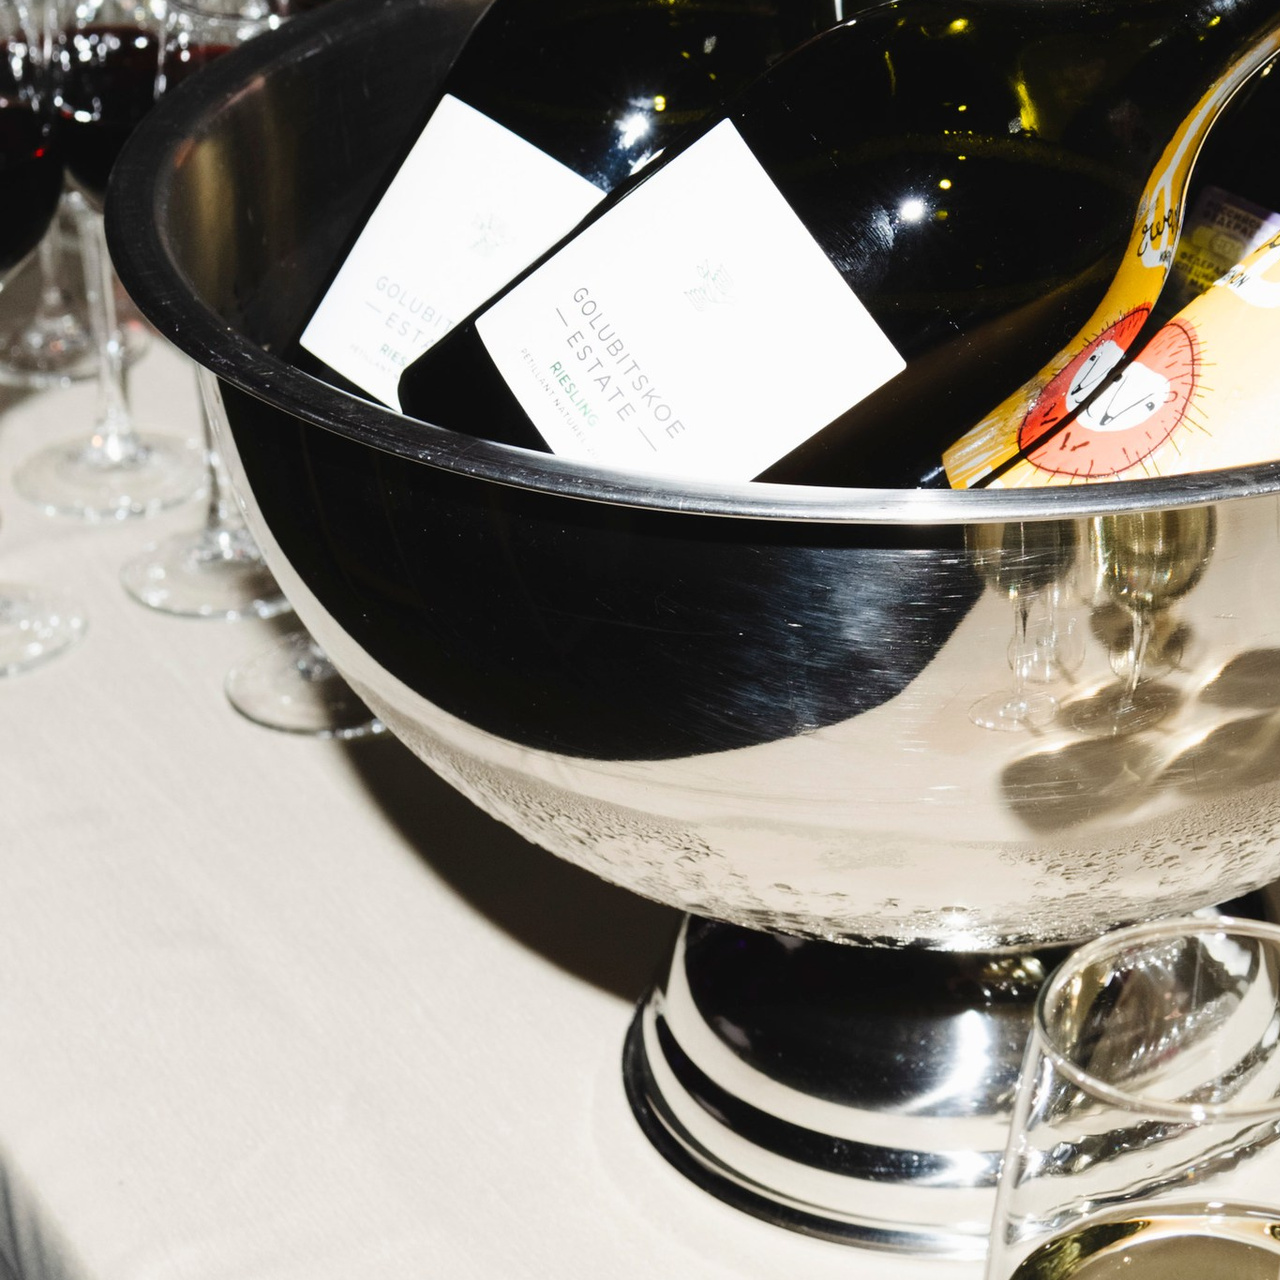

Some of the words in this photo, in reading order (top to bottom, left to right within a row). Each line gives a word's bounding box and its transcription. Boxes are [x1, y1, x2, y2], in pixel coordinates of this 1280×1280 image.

[375, 276, 455, 335] GOLUBIT
[550, 361, 600, 427] RIESLING
[566, 331, 637, 422] ESTATE
[573, 287, 686, 439] GOLUBITSKOE
